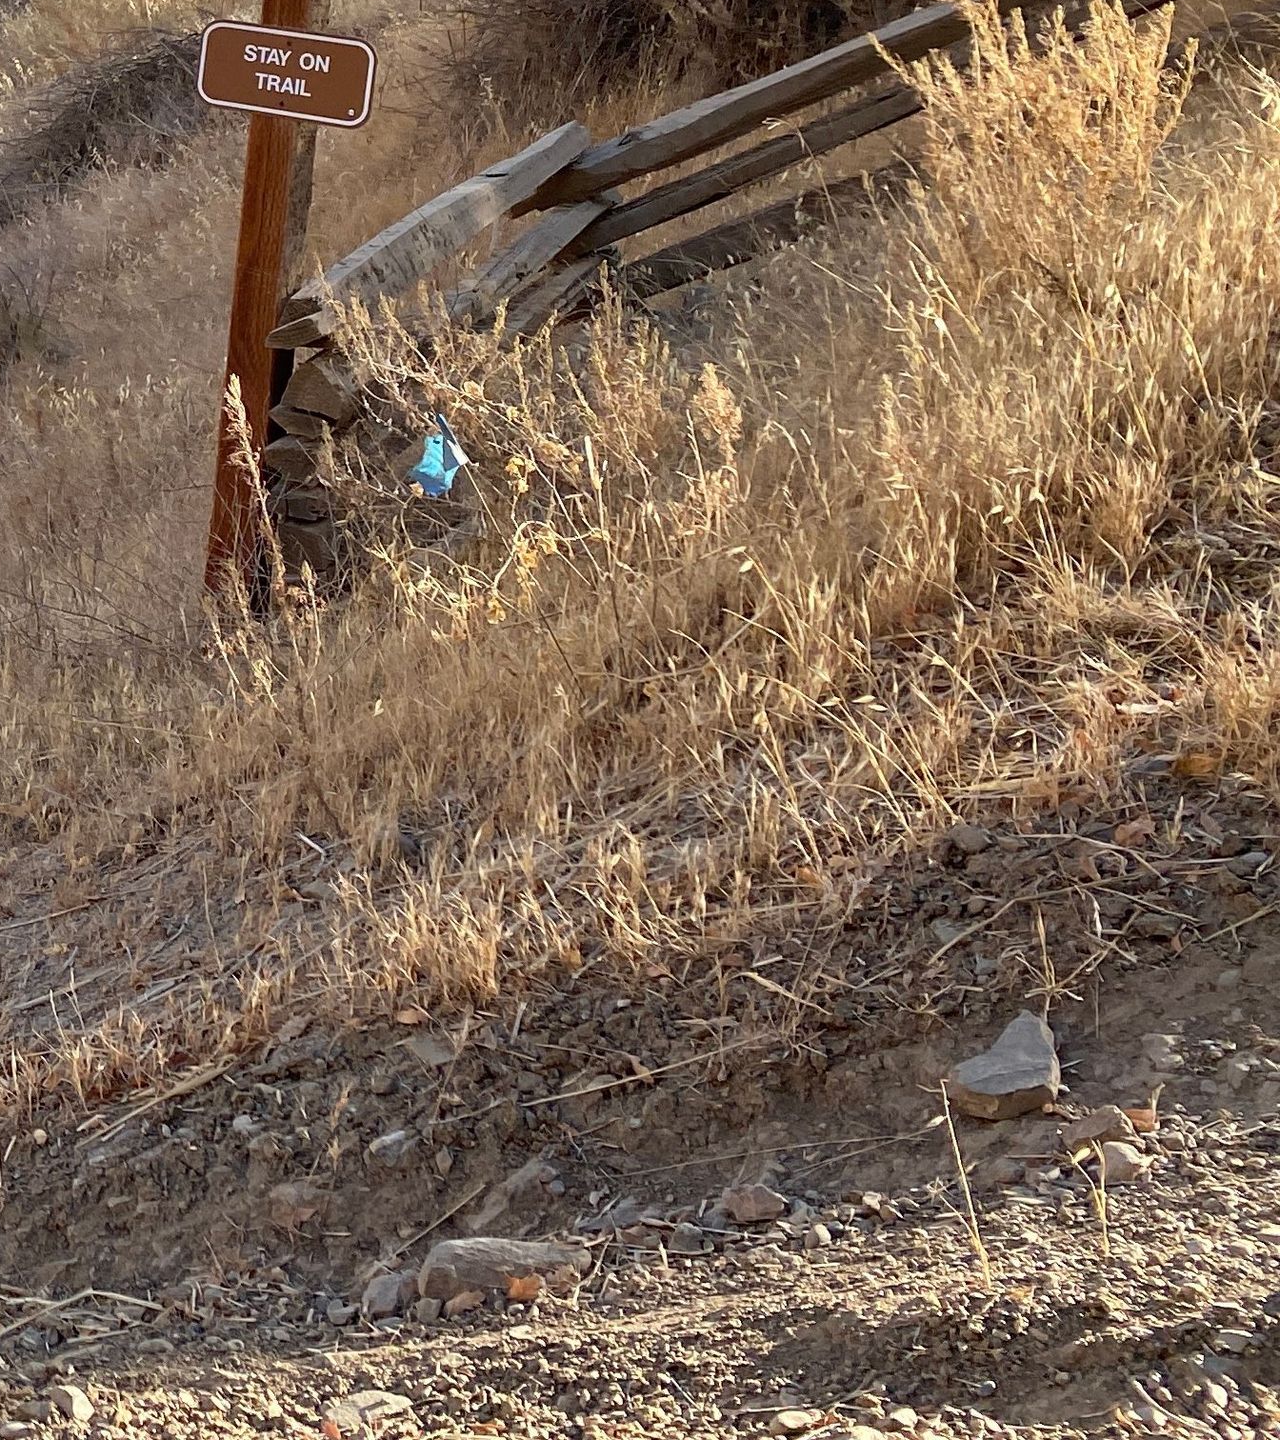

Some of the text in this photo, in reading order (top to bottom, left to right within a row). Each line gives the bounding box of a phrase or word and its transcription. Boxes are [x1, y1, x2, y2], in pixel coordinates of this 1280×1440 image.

[243, 44, 331, 73] STAY ON
[255, 72, 312, 97] TRAIL
